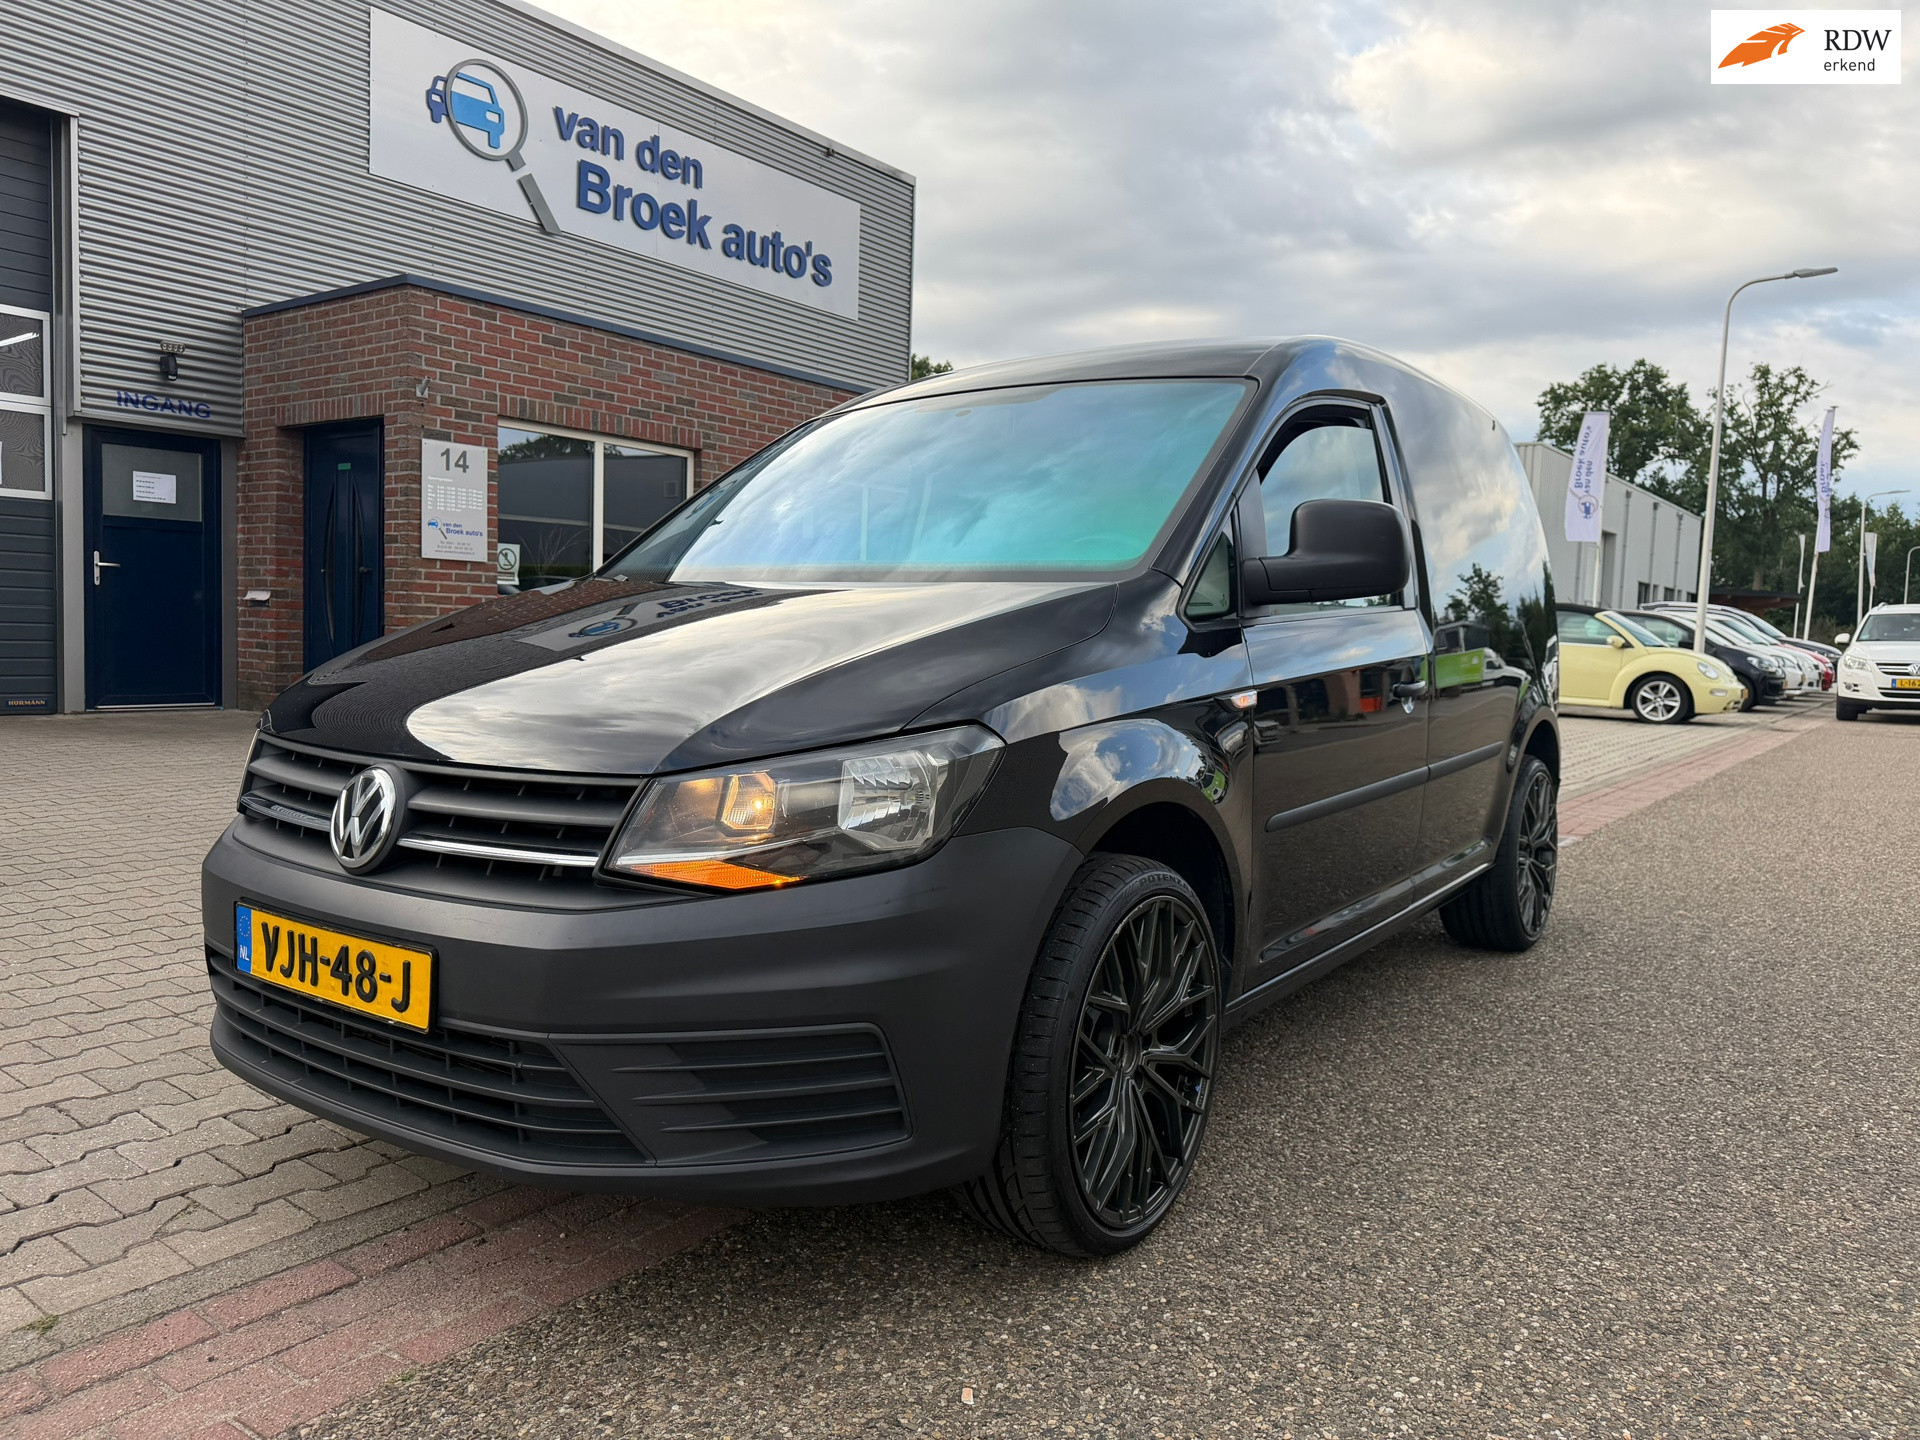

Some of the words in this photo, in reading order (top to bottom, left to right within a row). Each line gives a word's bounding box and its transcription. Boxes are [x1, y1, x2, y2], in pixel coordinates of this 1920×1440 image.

[553, 105, 624, 161] van
[636, 134, 703, 189] den
[577, 158, 712, 250] Broek
[722, 222, 833, 287] auto's
[116, 390, 211, 418] INGANG
[440, 448, 469, 473] 14
[445, 527, 464, 535] Broek
[239, 944, 250, 961] NL
[260, 920, 411, 1013] VJH-48-J
